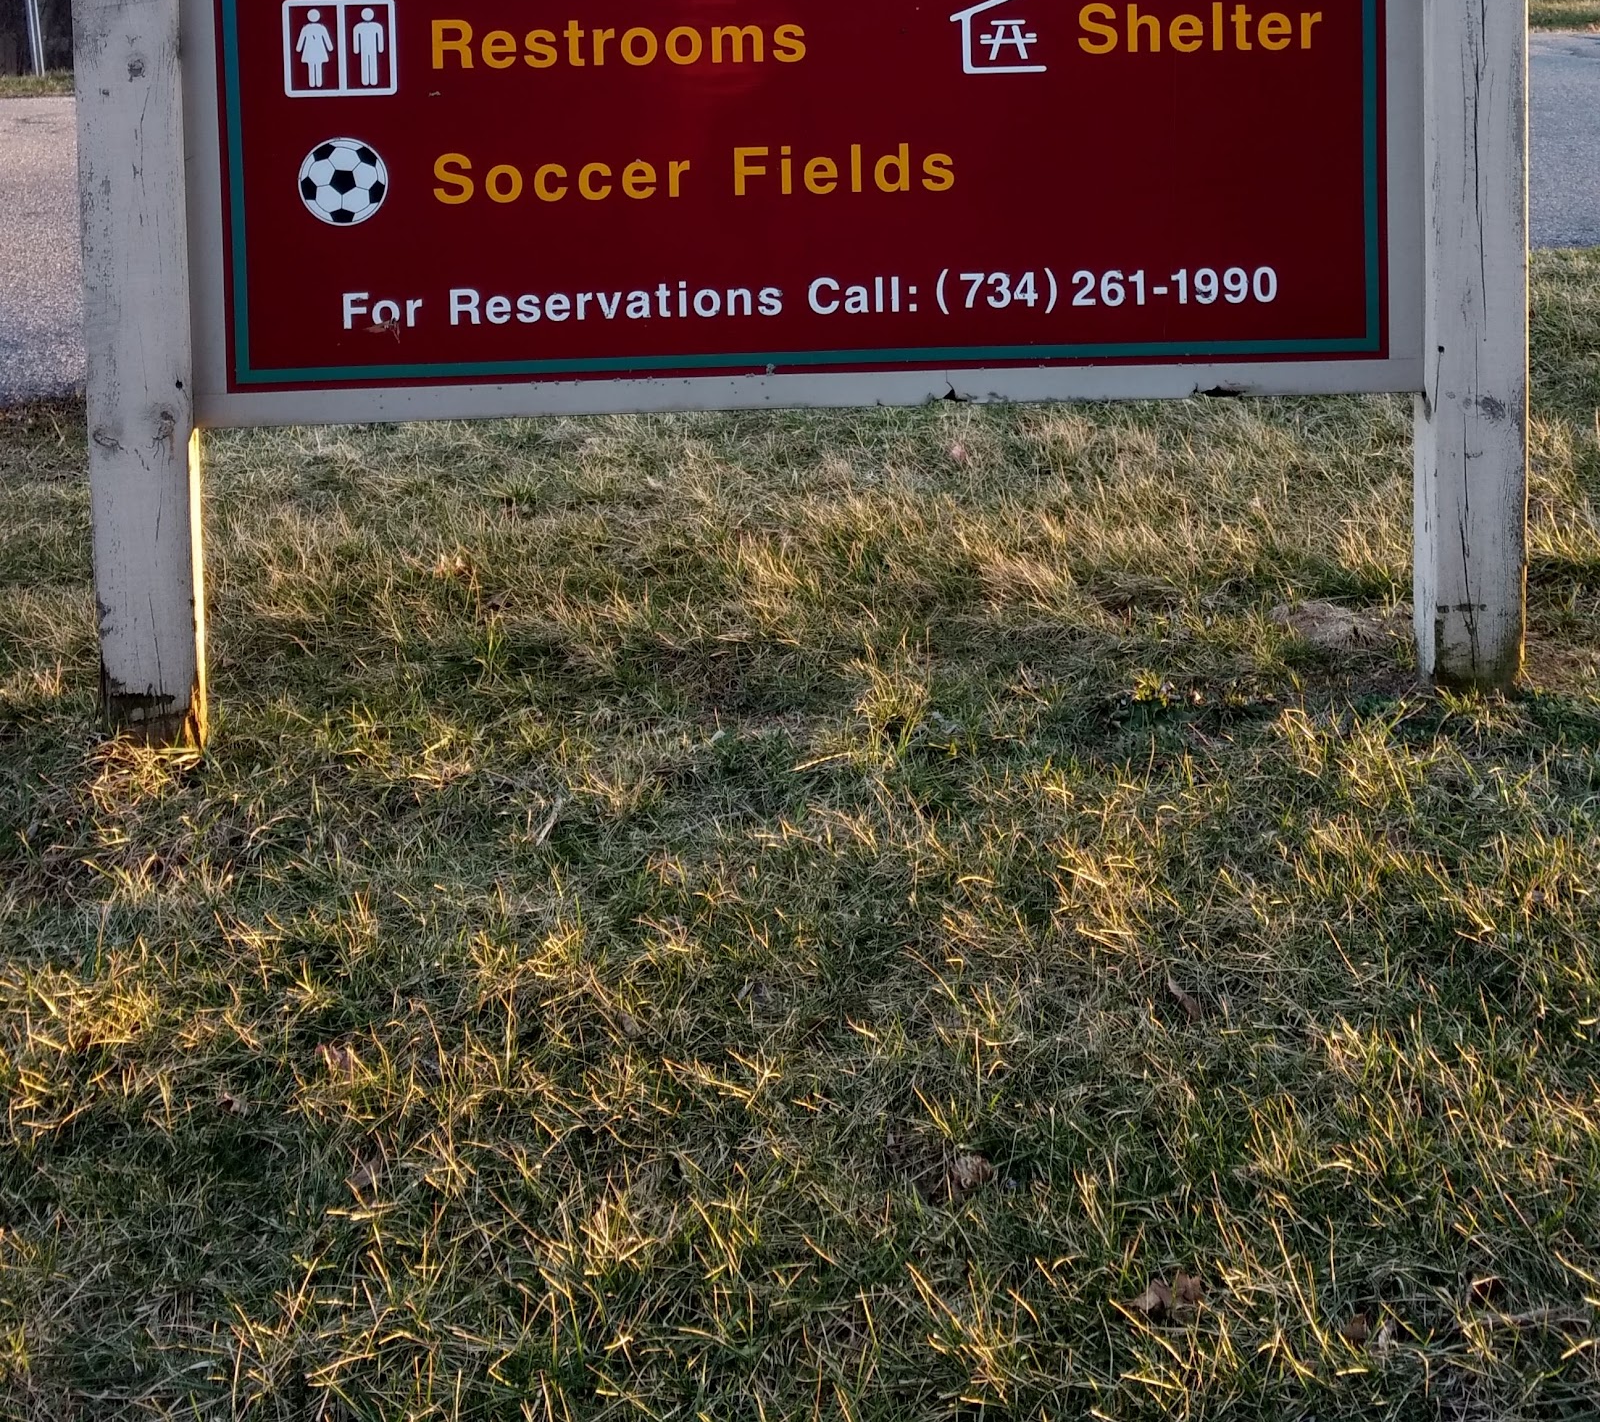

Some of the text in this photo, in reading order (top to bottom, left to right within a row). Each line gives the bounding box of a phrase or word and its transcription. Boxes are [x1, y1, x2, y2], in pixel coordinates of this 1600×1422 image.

[431, 18, 807, 70] Restrooms
[1077, 1, 1323, 55] Shelter
[432, 142, 955, 205] Soccer Fields
[342, 266, 1278, 330] For Reservations Call: (734) 261-1990
